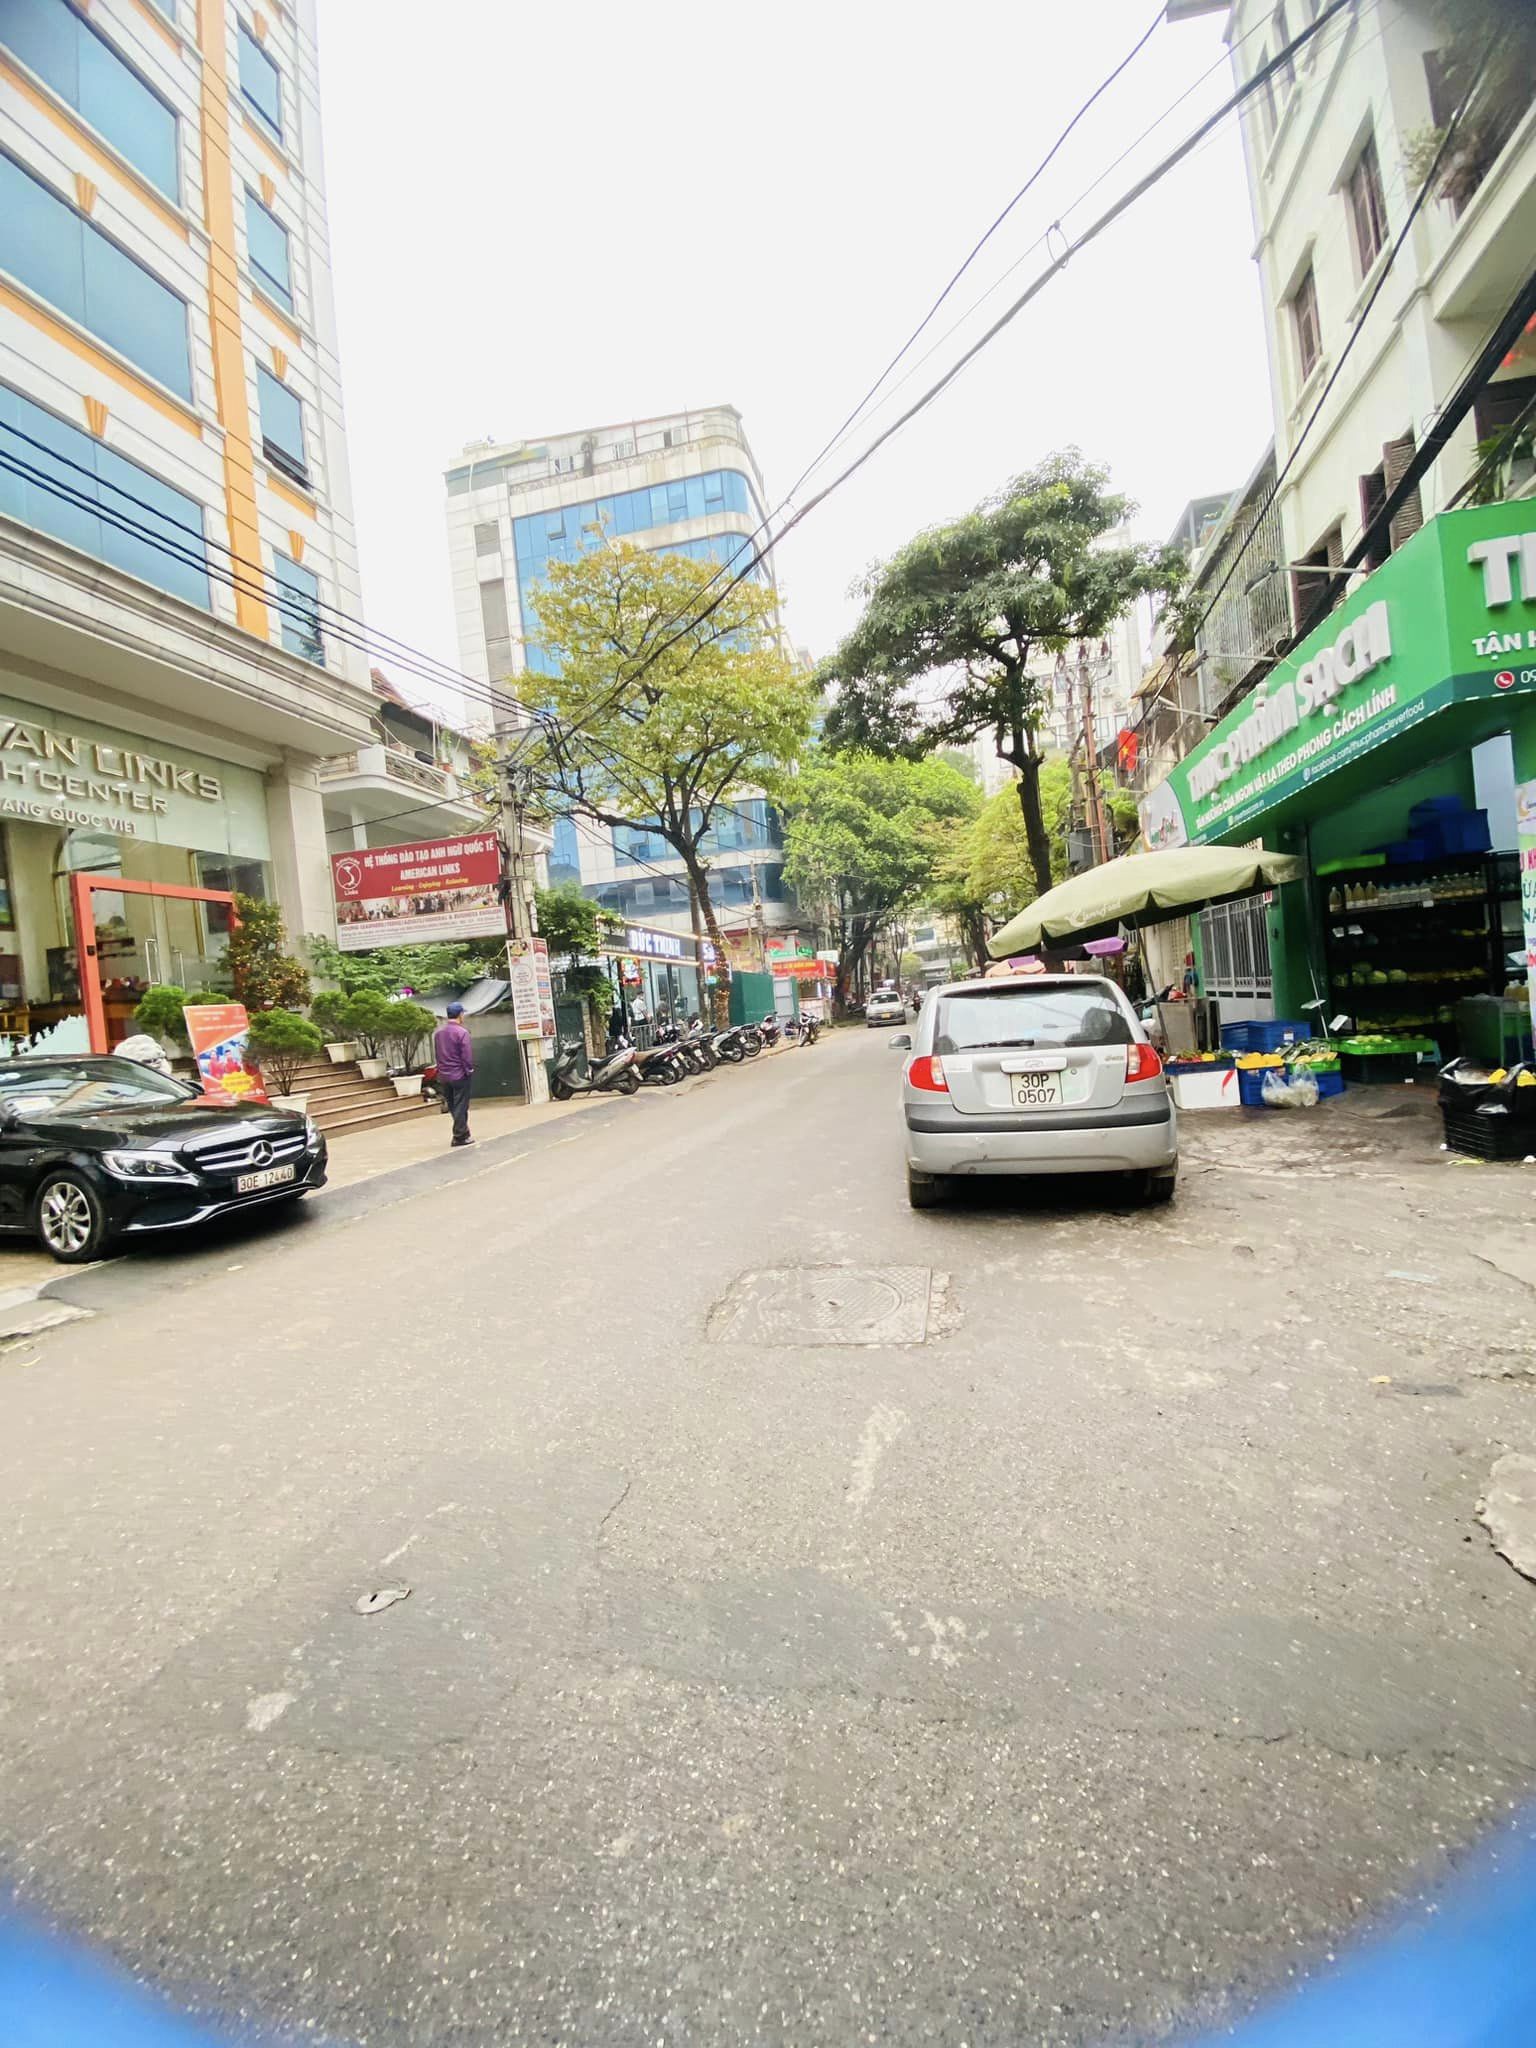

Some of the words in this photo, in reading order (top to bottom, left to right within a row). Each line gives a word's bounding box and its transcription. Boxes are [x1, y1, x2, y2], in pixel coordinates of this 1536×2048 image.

[1295, 600, 1392, 719] SẠCH
[1471, 631, 1522, 661] TẬN
[1276, 752, 1297, 777] THEO
[1296, 727, 1332, 764] PHONG
[1332, 709, 1365, 740] CÁCH
[1365, 683, 1397, 720] LÍNH
[93, 743, 222, 801] LINKS
[36, 769, 169, 816] CENTER
[375, 850, 399, 867] THỐNG
[415, 849, 430, 864] TẠO
[430, 846, 446, 860] ANH
[463, 838, 484, 856] QUỐC
[485, 836, 495, 852] TẾ
[400, 864, 438, 881] AMERICAN
[438, 862, 460, 876] LINKS
[1017, 1088, 1056, 1104] 0507
[1021, 1073, 1050, 1089] 30P
